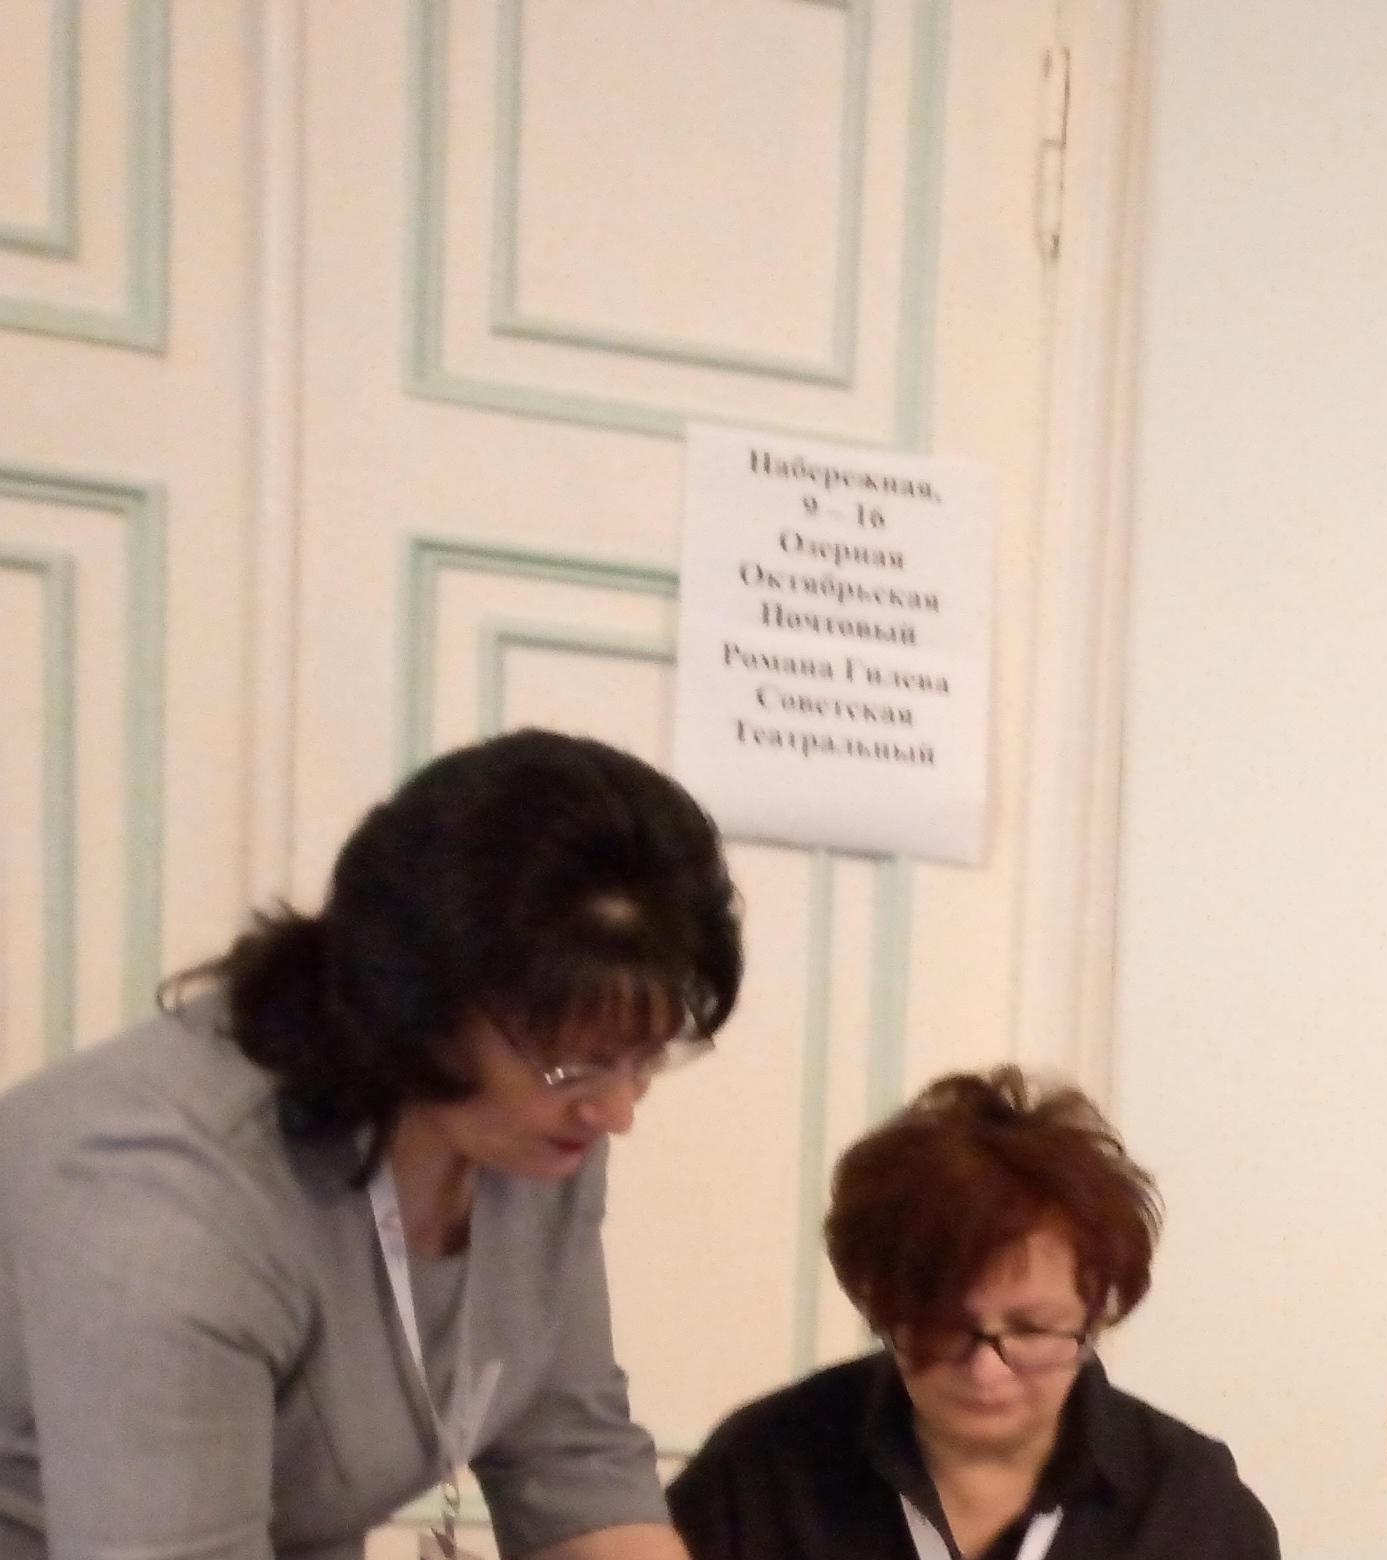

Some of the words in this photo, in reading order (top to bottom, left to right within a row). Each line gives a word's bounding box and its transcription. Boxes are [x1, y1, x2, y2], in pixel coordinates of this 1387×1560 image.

[748, 446, 941, 502] Набережная,
[857, 502, 886, 528] 16
[779, 529, 906, 570] Озерная
[739, 561, 940, 613] Октябрьская
[761, 600, 917, 646] Почтовый
[723, 640, 834, 680] Романа
[756, 685, 914, 727] Советская
[733, 717, 935, 766] Театральный
